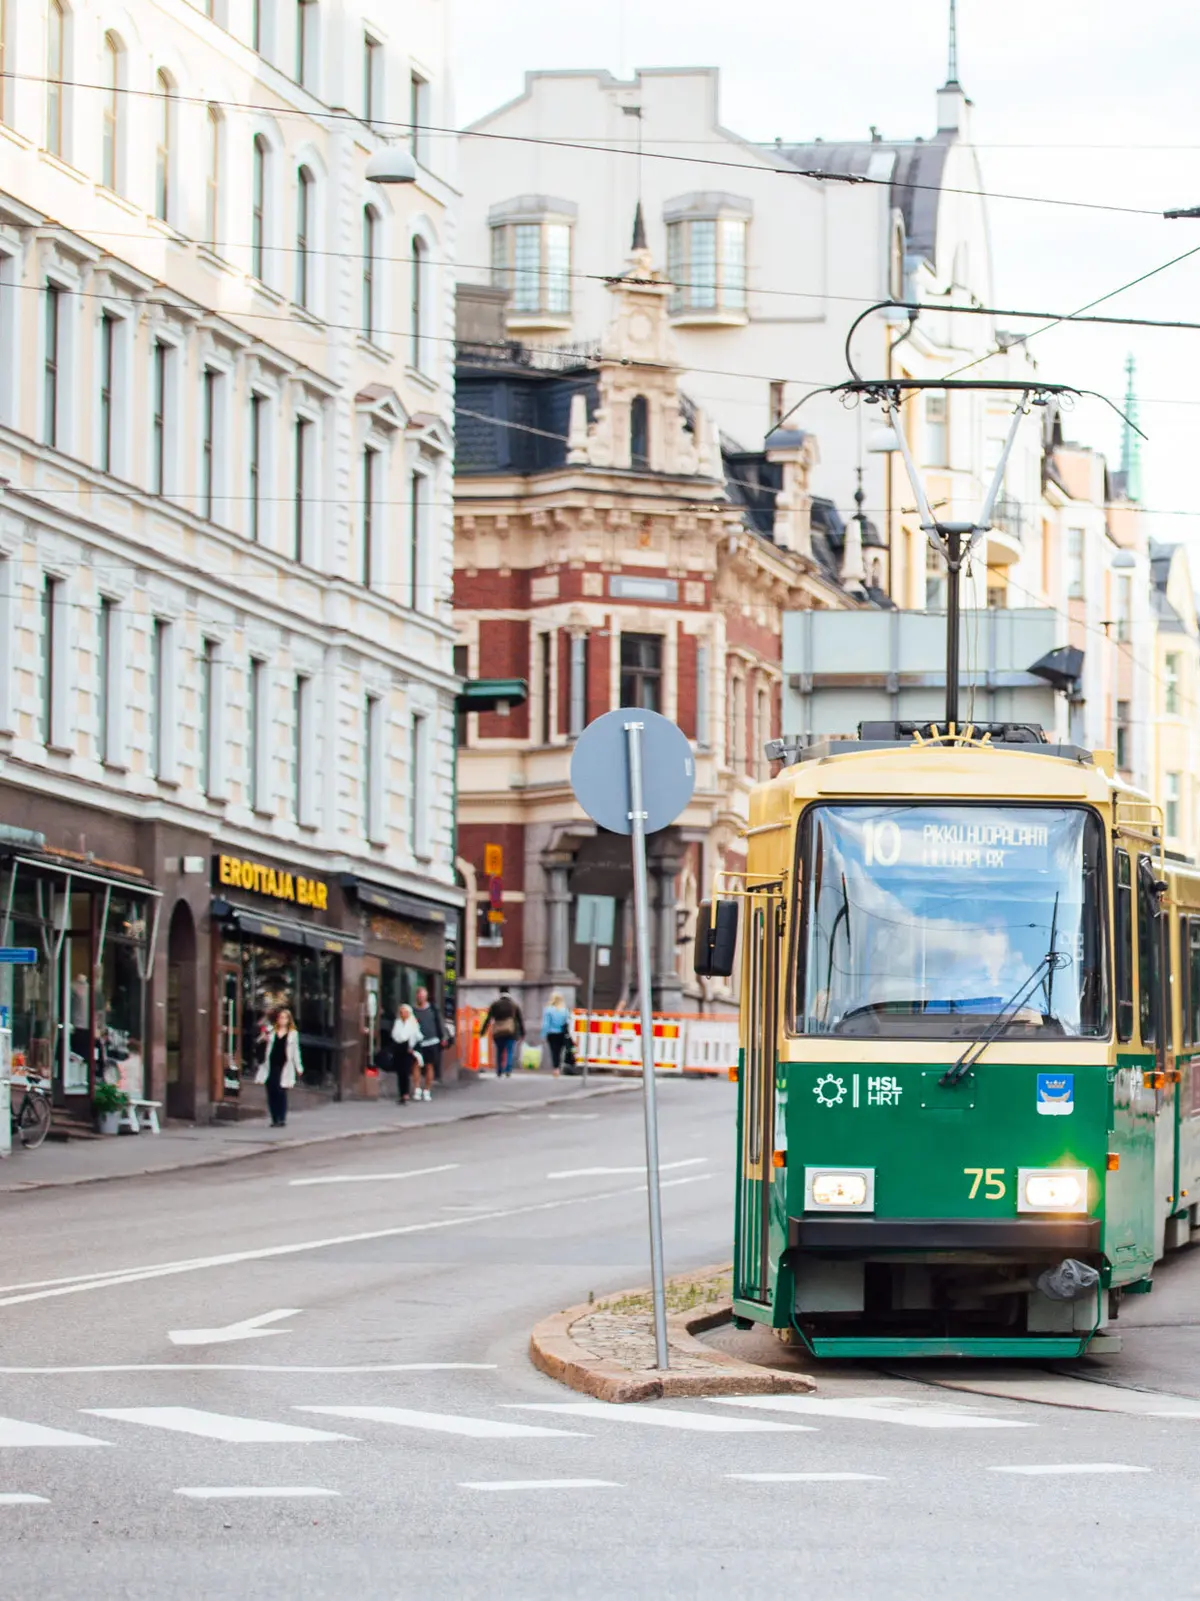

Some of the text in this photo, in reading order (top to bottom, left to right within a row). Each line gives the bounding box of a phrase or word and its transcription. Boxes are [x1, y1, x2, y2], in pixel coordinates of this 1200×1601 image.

[862, 820, 901, 867] 10
[219, 854, 328, 911] EROTTAJA BAR
[867, 1076, 902, 1091] HSL
[867, 1091, 903, 1106] HRT
[963, 1168, 1006, 1200] 75
